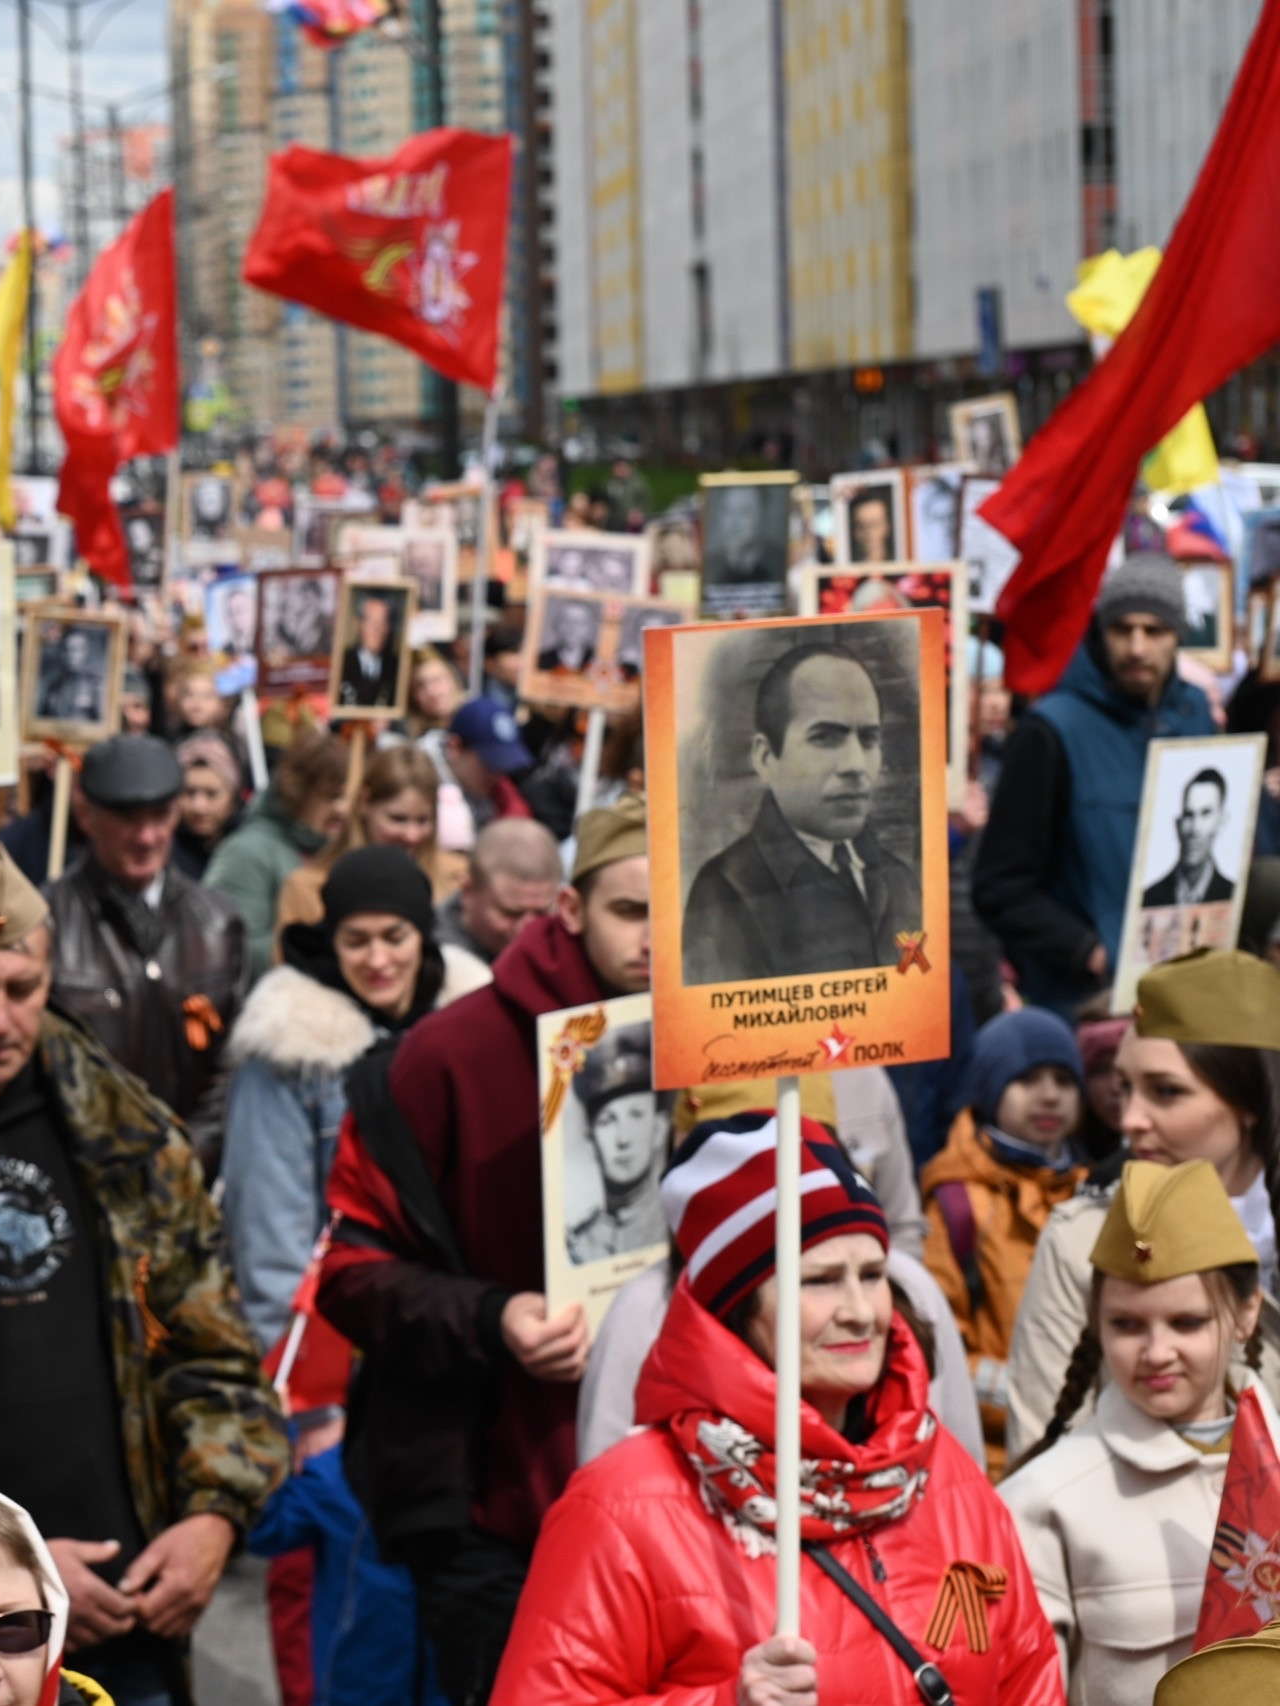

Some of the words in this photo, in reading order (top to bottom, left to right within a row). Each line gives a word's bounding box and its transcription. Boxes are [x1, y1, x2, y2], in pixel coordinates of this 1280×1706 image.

[710, 983, 815, 1009] ПУТИМЦЕВ
[819, 972, 888, 999] СЕРГЕЙ
[733, 1001, 868, 1030] МИХАЙЛОВИЧ
[853, 1041, 906, 1062] ПОЛК
